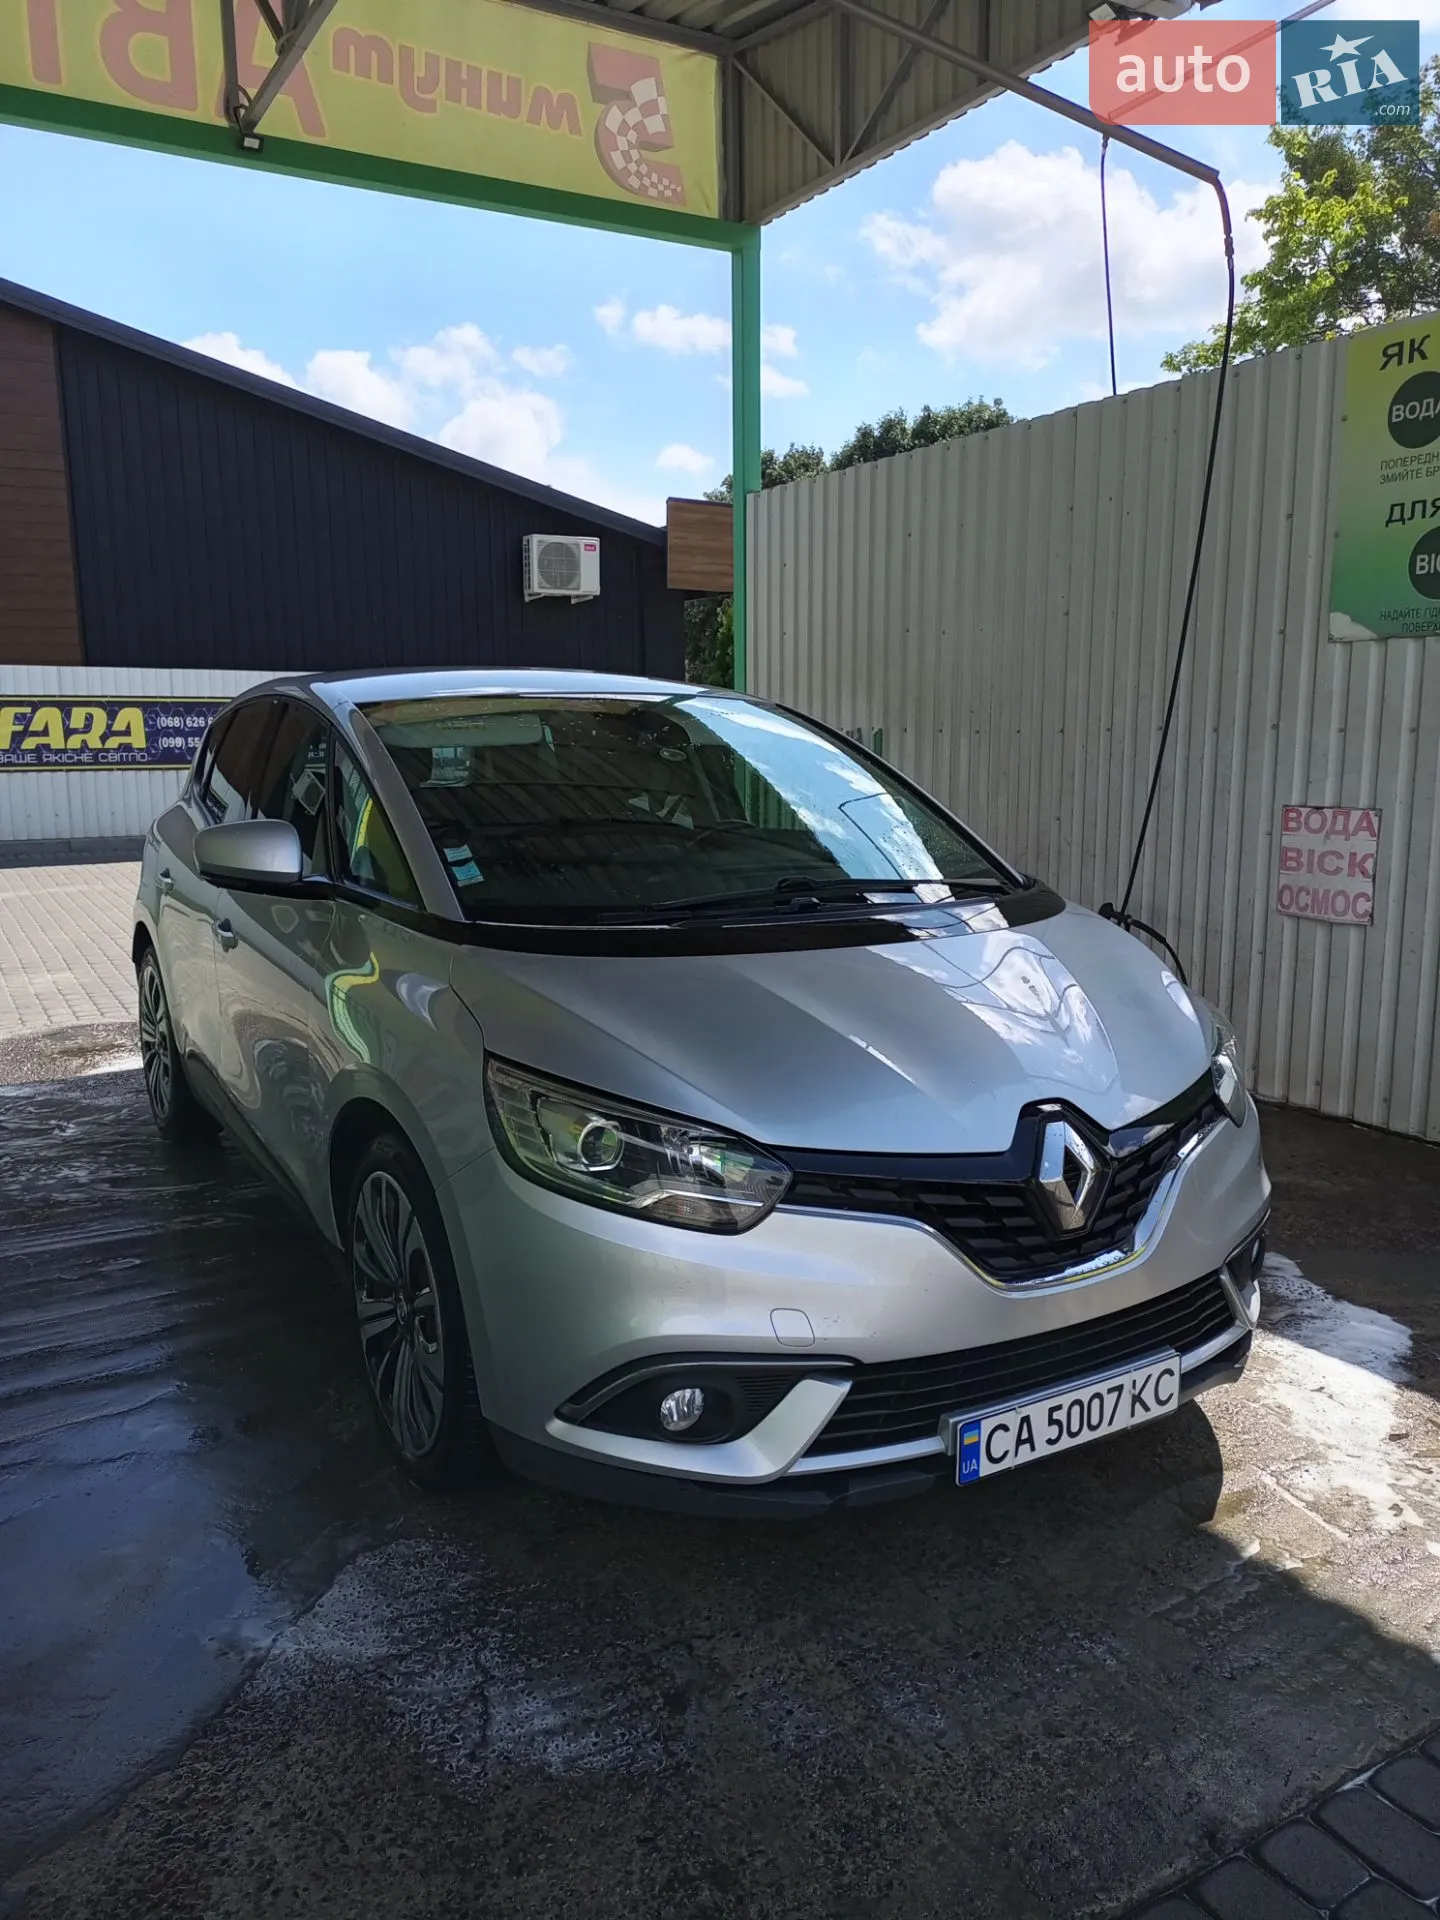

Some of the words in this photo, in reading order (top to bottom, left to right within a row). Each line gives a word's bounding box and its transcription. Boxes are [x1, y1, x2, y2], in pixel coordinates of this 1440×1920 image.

[1379, 334, 1431, 371] ЯК
[0, 707, 146, 750] FARA
[156, 715, 184, 730] (068)
[186, 716, 205, 728] 626
[42, 752, 94, 763] ЯКІСНЕ
[158, 736, 186, 750] (099)
[1283, 807, 1377, 841] ВОДА
[1280, 846, 1374, 879] ВІСК
[1278, 883, 1371, 920] ОСМОС
[985, 1414, 1036, 1465] CA
[1045, 1383, 1125, 1446] 5007
[1130, 1367, 1175, 1418] KC
[962, 1459, 978, 1474] UA
